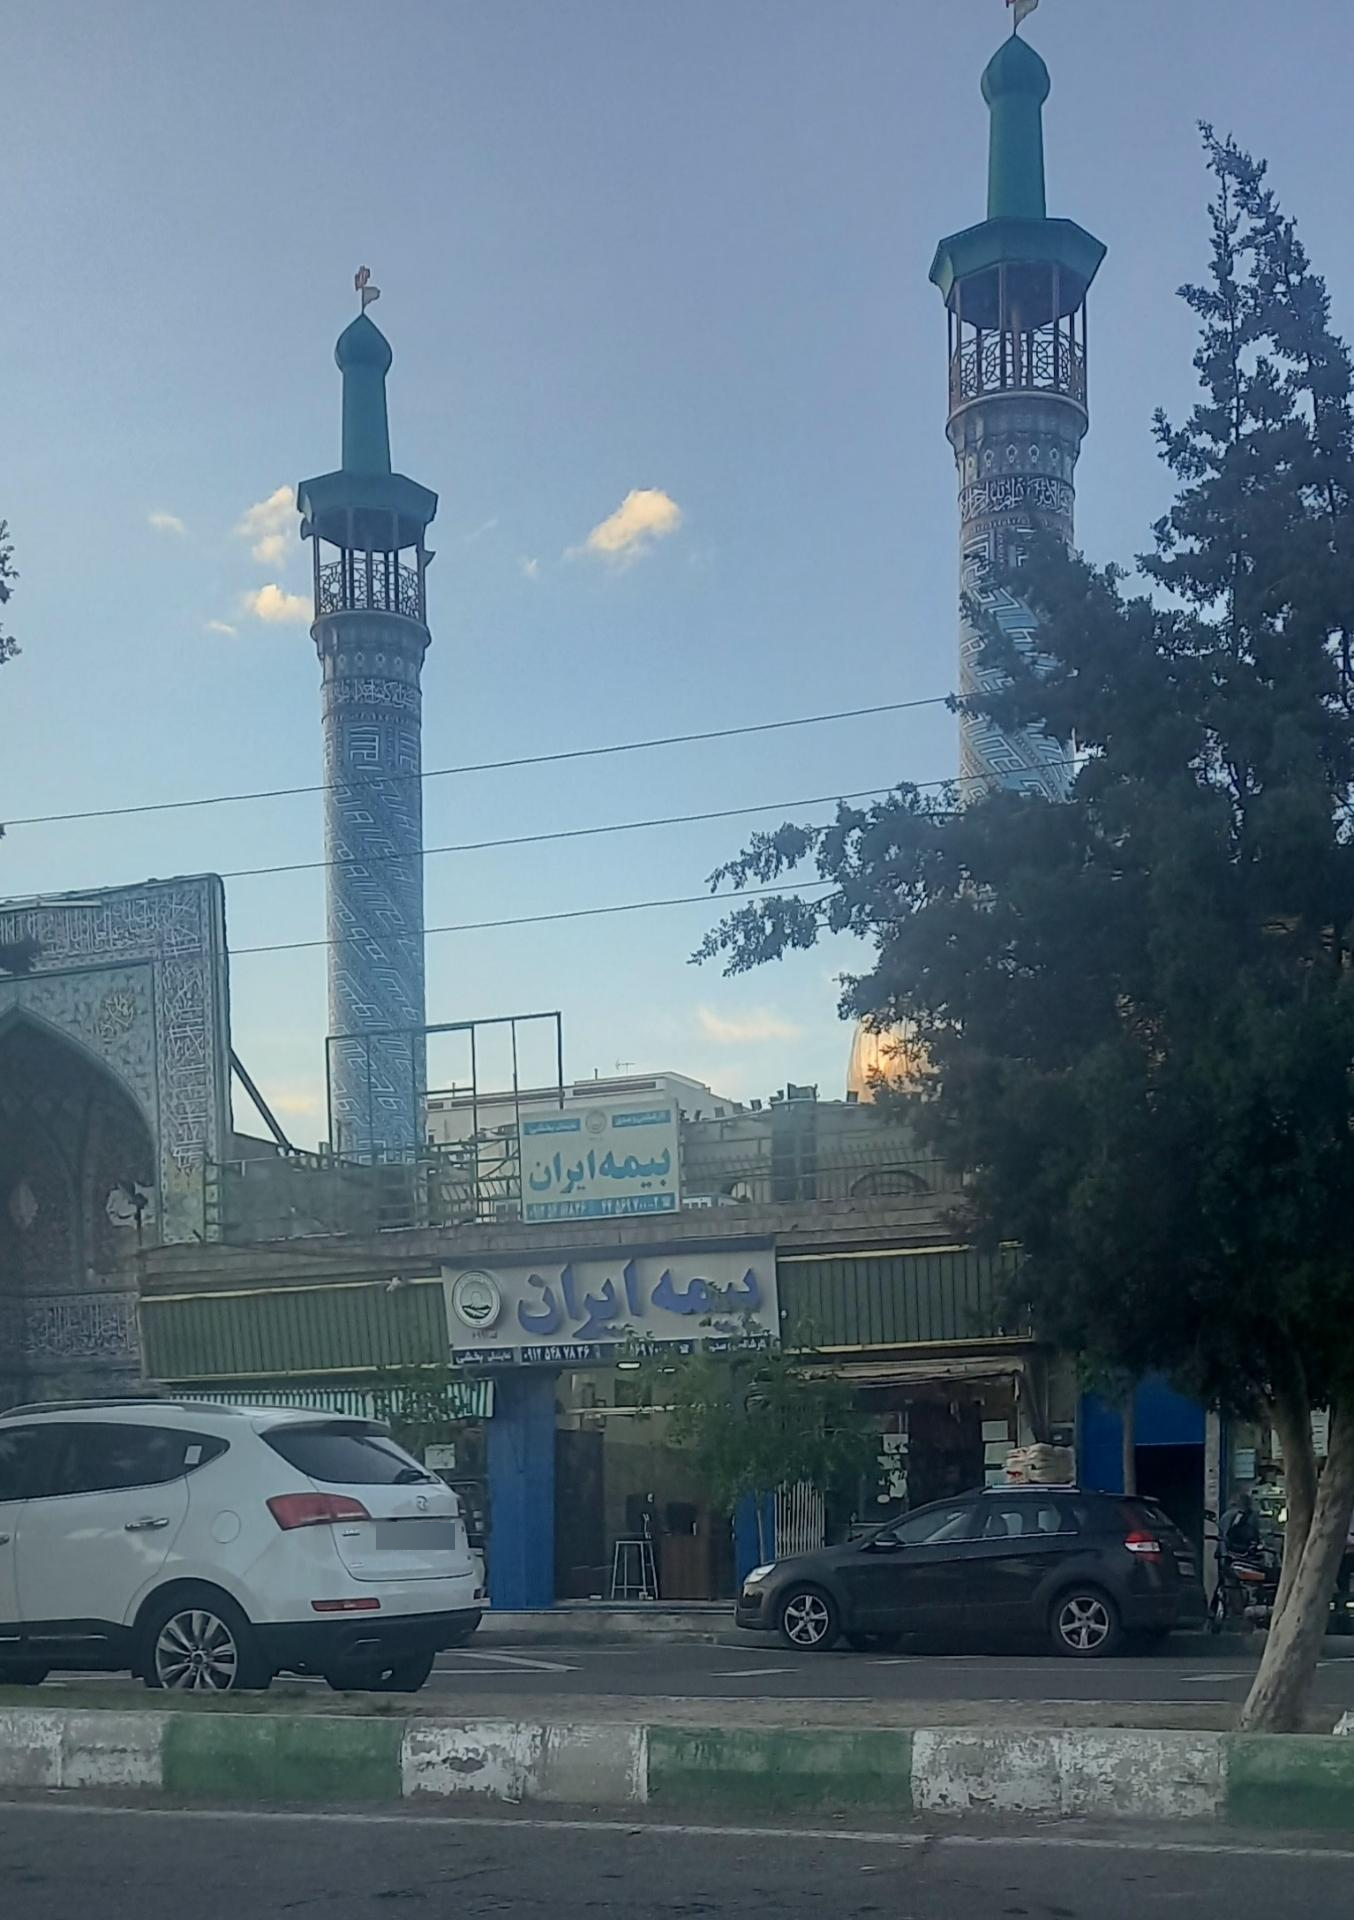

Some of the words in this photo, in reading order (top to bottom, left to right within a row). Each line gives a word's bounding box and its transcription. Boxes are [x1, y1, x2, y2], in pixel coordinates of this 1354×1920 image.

[529, 1149, 596, 1194] ایران
[600, 1147, 671, 1188] بیمه
[517, 1257, 645, 1341] ایران
[651, 1267, 762, 1333] بیمه
